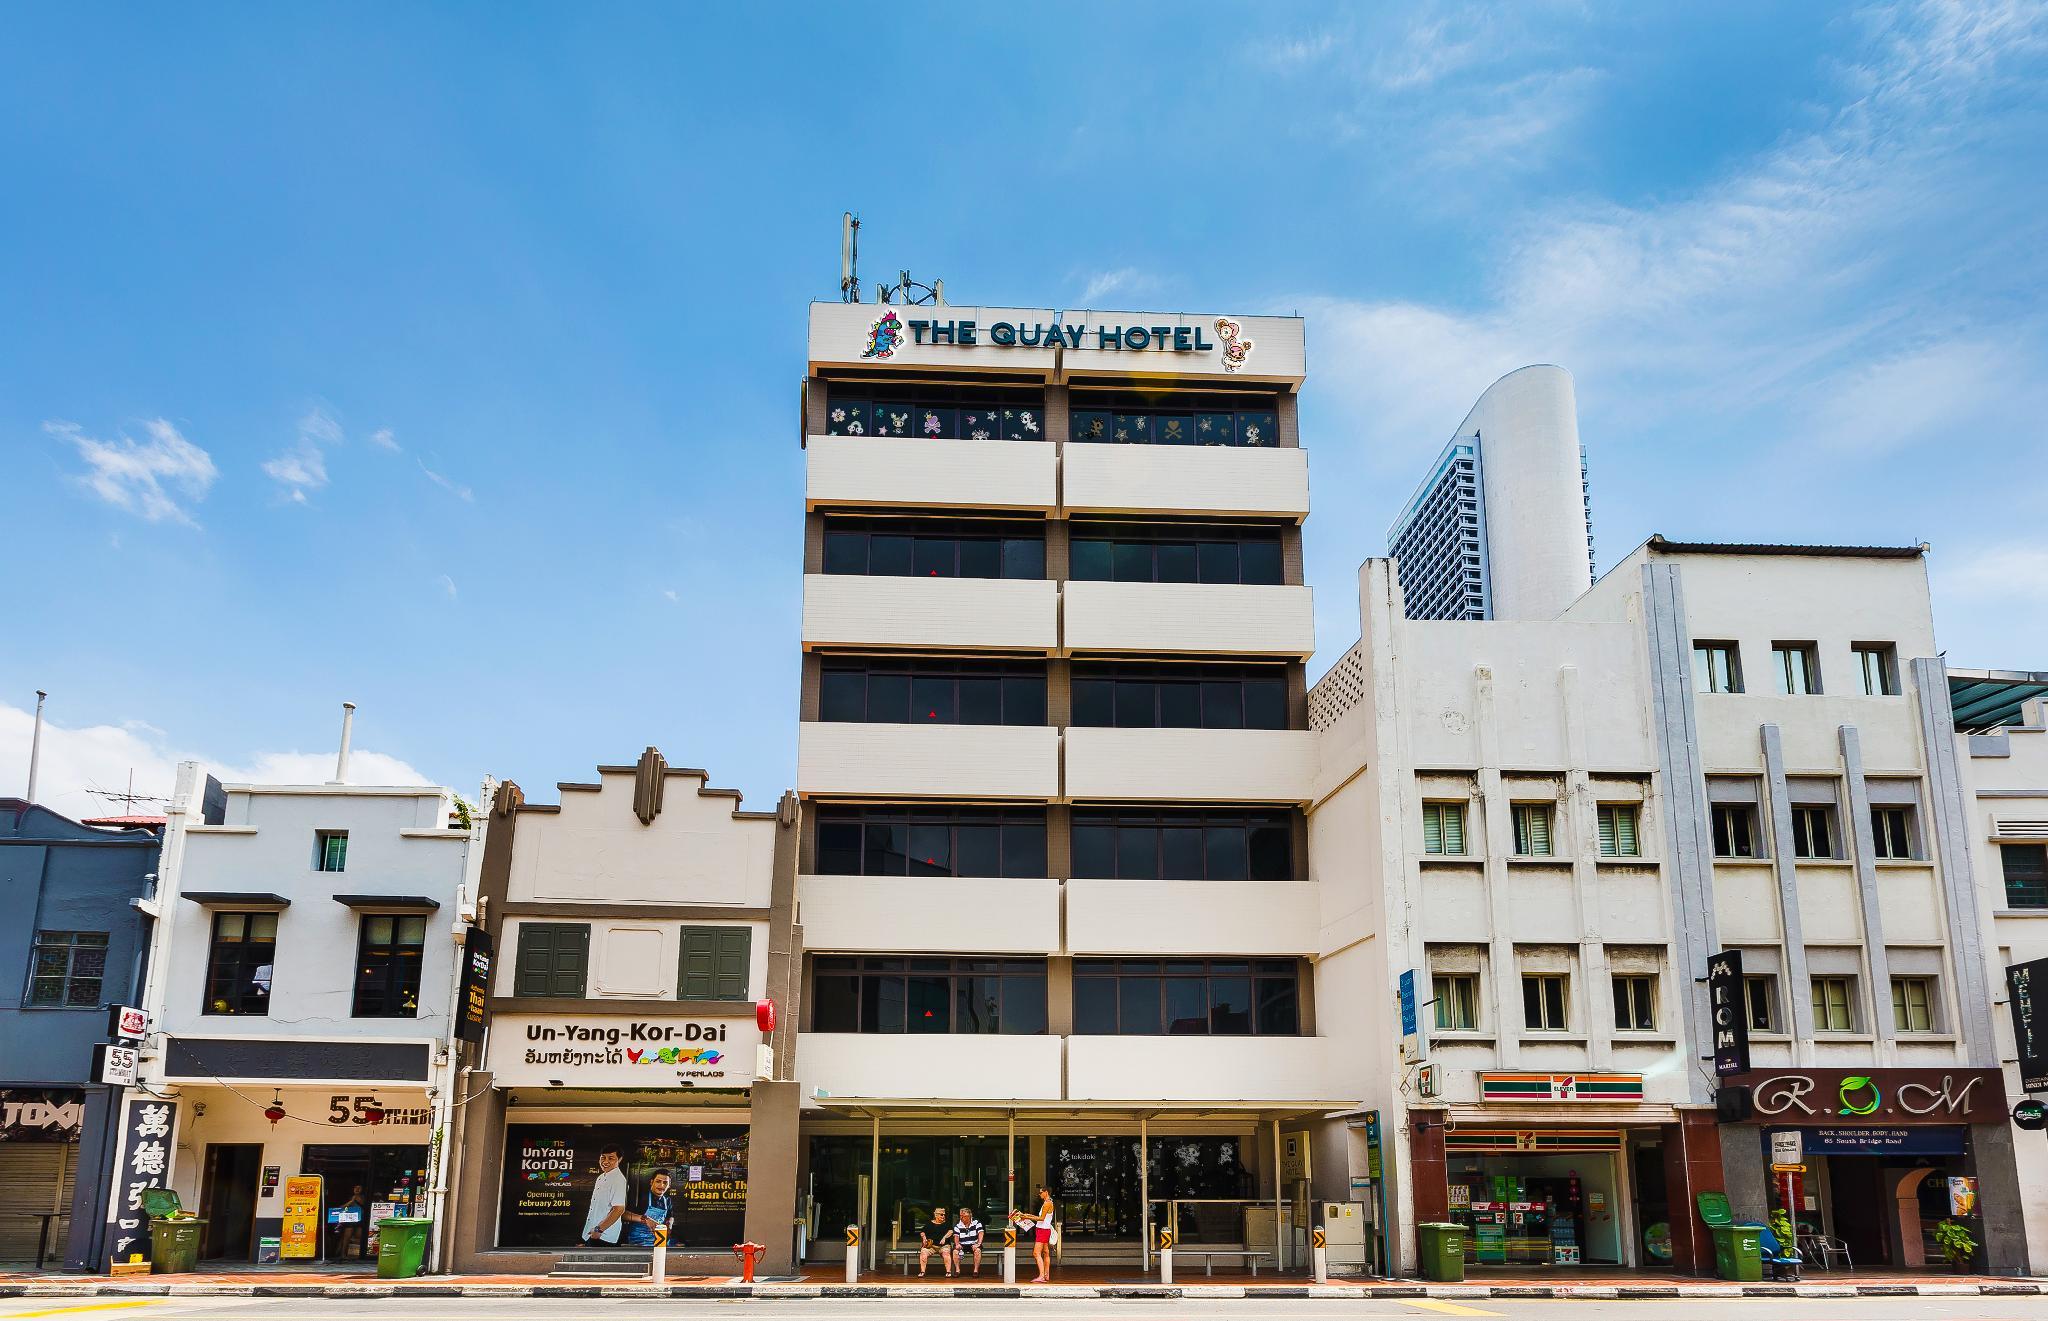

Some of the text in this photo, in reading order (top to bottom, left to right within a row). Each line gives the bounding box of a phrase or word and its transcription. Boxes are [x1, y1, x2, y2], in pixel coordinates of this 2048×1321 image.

[908, 319, 1213, 351] THE QUAY HOTEL
[469, 991, 484, 1007] Thai
[526, 1023, 726, 1045] Un-Yang-Kor-Dai
[111, 1049, 133, 1068] 55
[523, 1148, 573, 1159] UnYang
[521, 1159, 573, 1170] KorDai
[526, 1191, 555, 1199] Opening
[690, 1190, 719, 1200] Isaan
[518, 1200, 551, 1208] February
